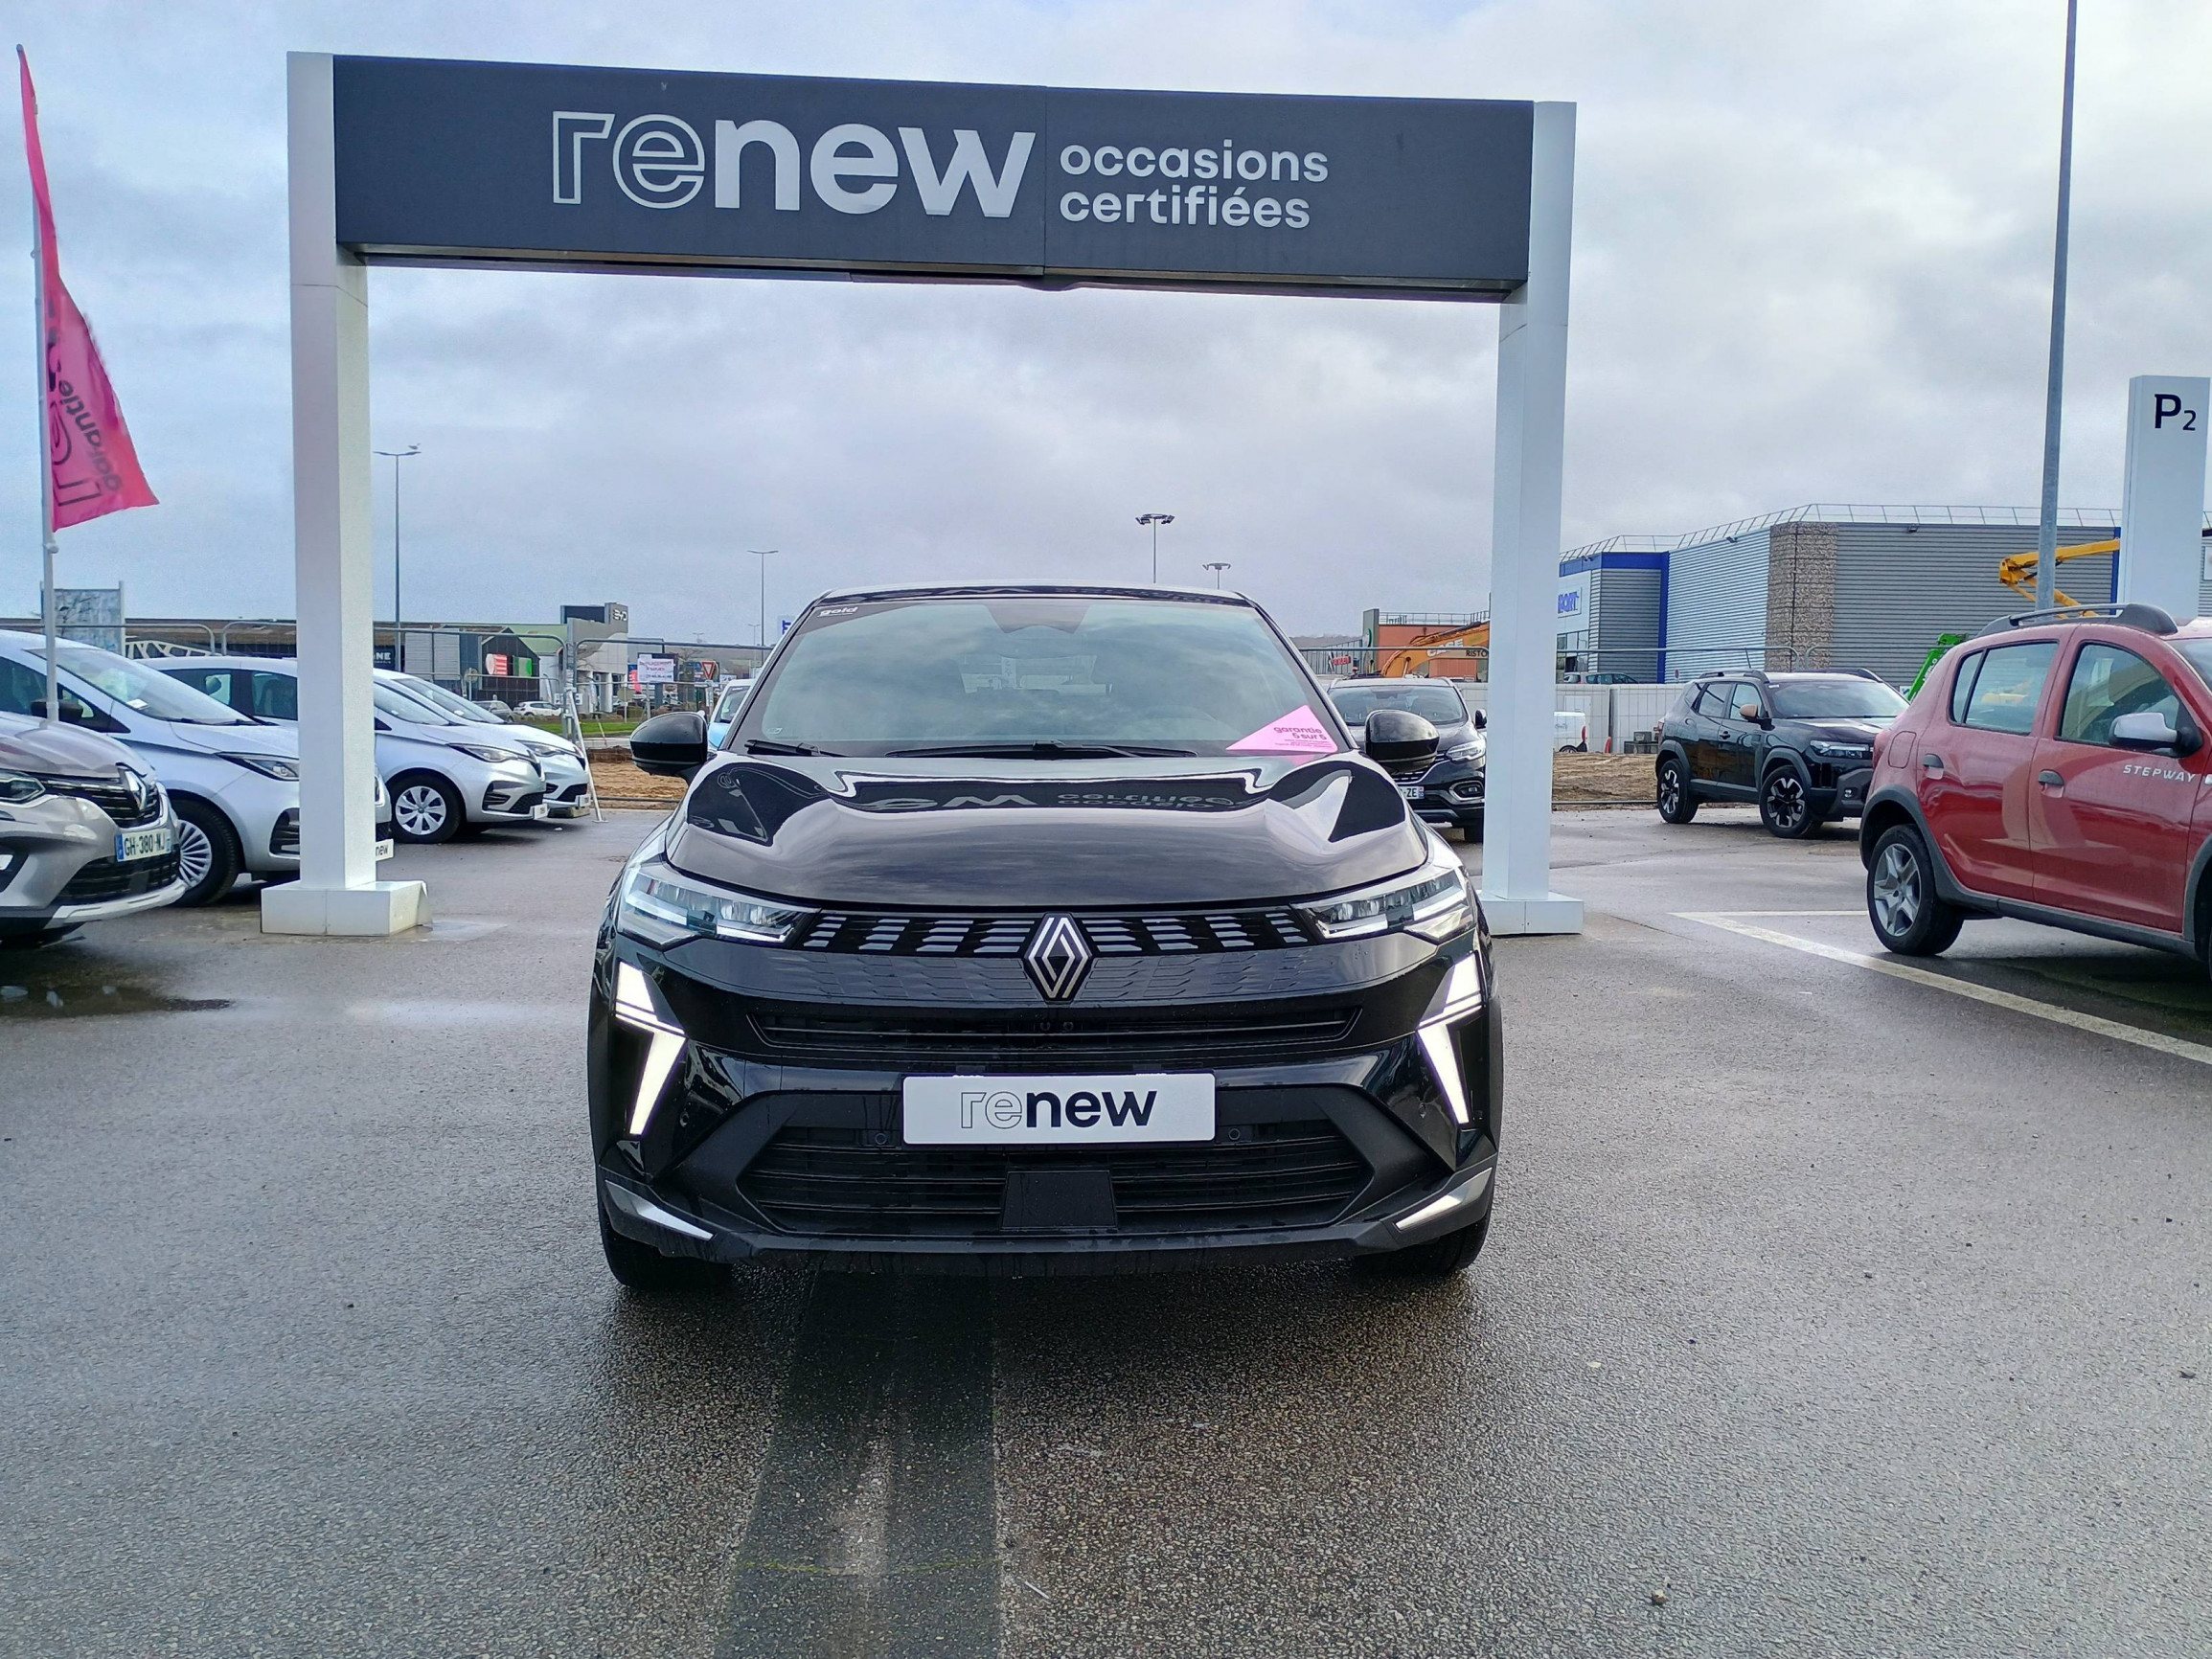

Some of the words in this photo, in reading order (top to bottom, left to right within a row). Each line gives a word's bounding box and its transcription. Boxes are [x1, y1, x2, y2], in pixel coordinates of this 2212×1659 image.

[553, 111, 1037, 217] renew
[1060, 139, 1329, 182] occasions
[1060, 184, 1311, 229] certifiées
[817, 606, 858, 618] gold
[2123, 764, 2196, 783] STEPWAY
[961, 1090, 1158, 1129] renew
